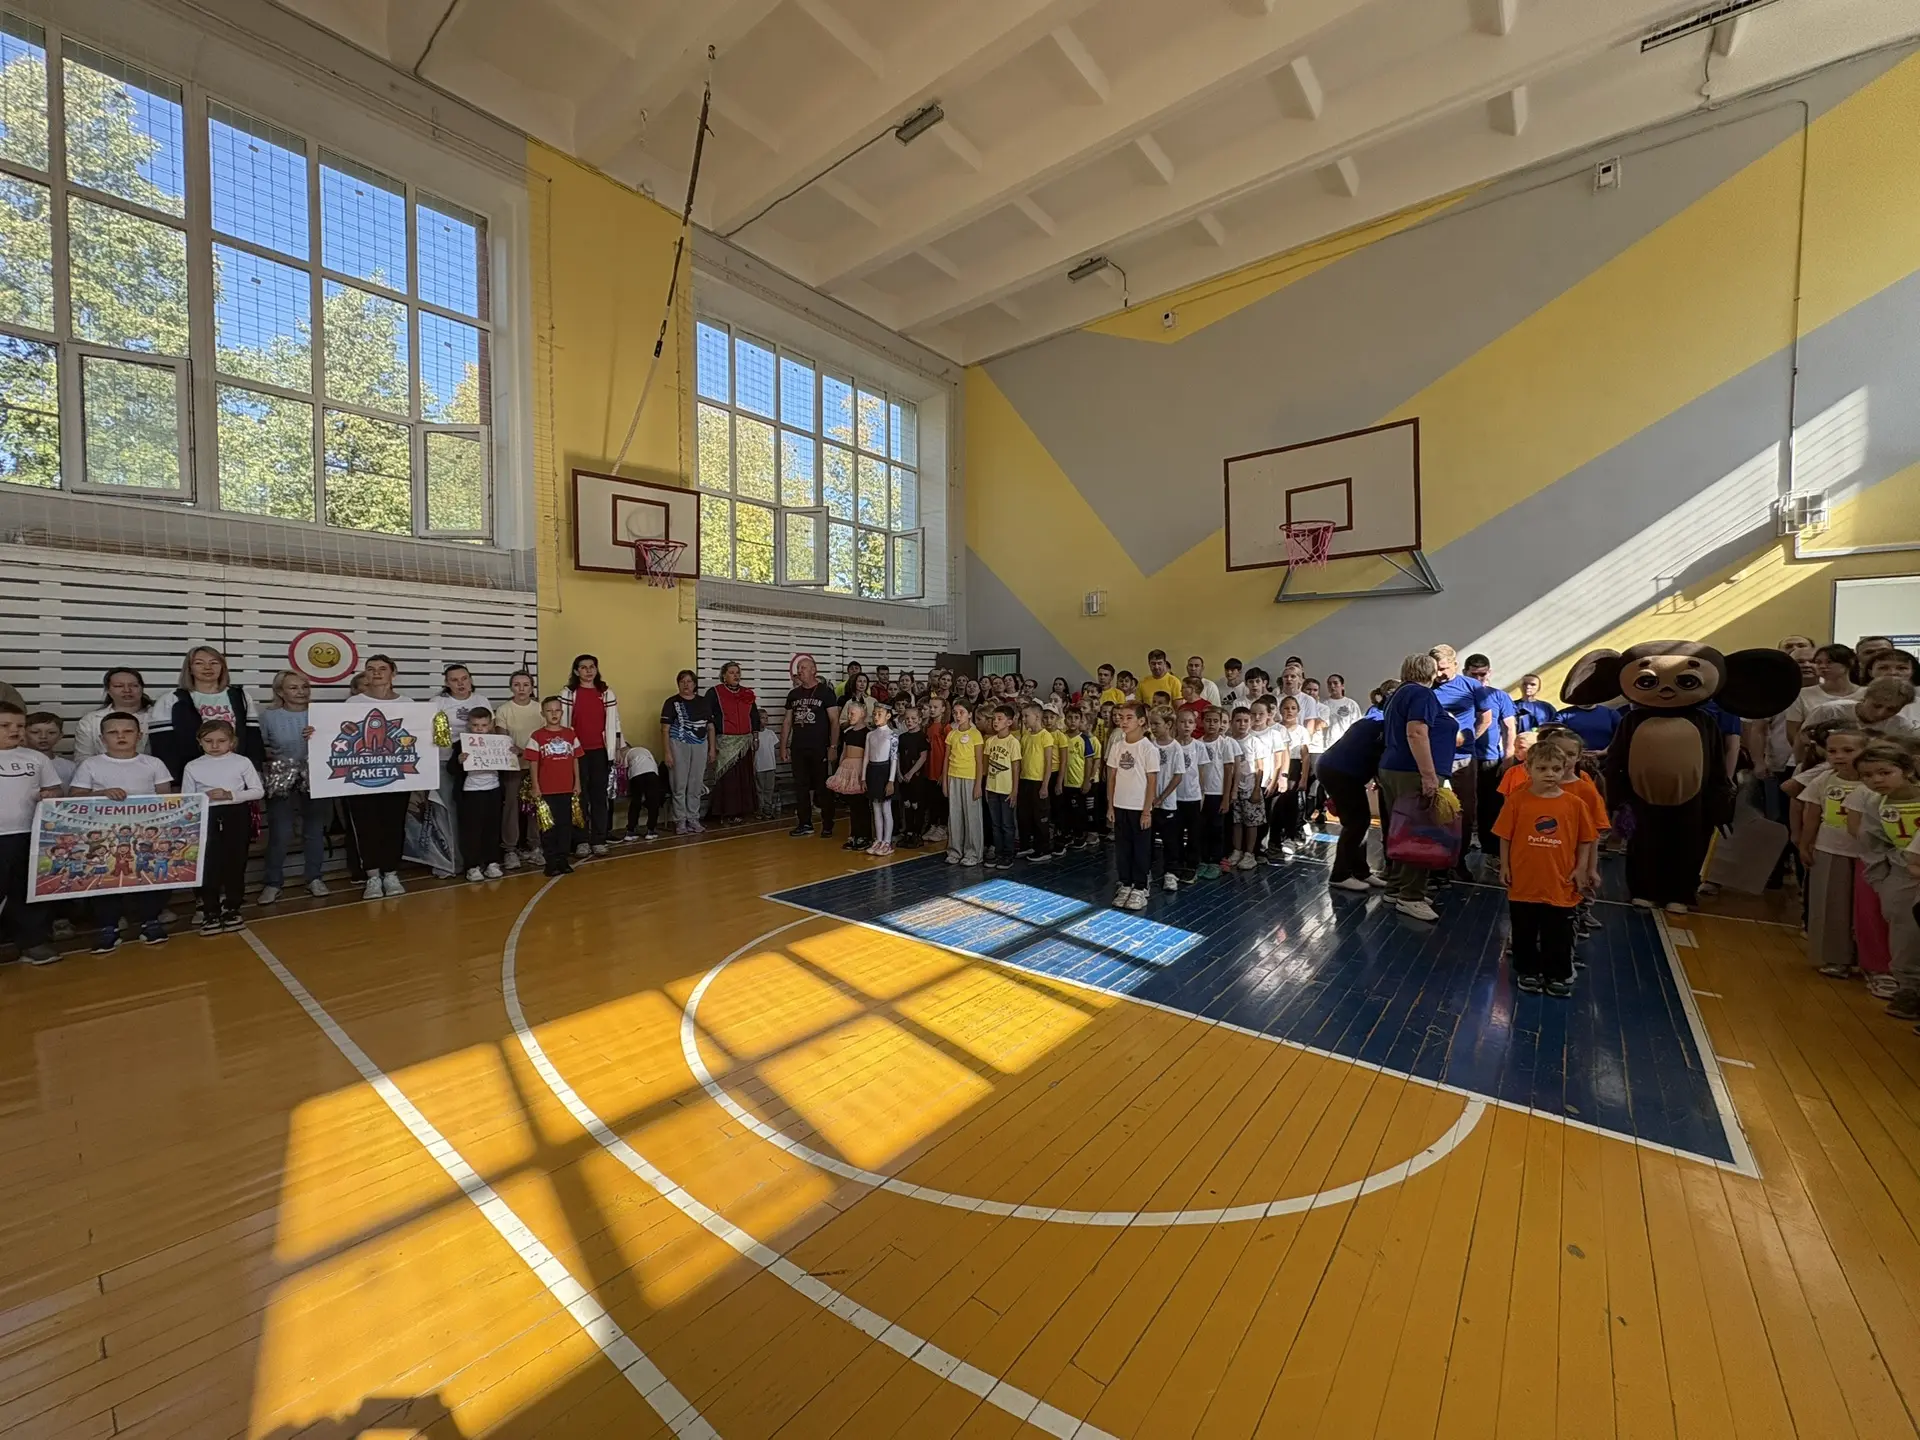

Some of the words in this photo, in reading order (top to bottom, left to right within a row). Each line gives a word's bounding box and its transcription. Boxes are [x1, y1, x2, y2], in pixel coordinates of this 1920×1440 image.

[331, 755, 383, 767] ГИМНАЗИЯ
[404, 754, 416, 762] 2В
[352, 767, 399, 779] РАКЕТА
[68, 804, 89, 814] 2В
[94, 800, 181, 815] ЧЕМПИОНЫ
[1527, 835, 1562, 845] РусГидро
